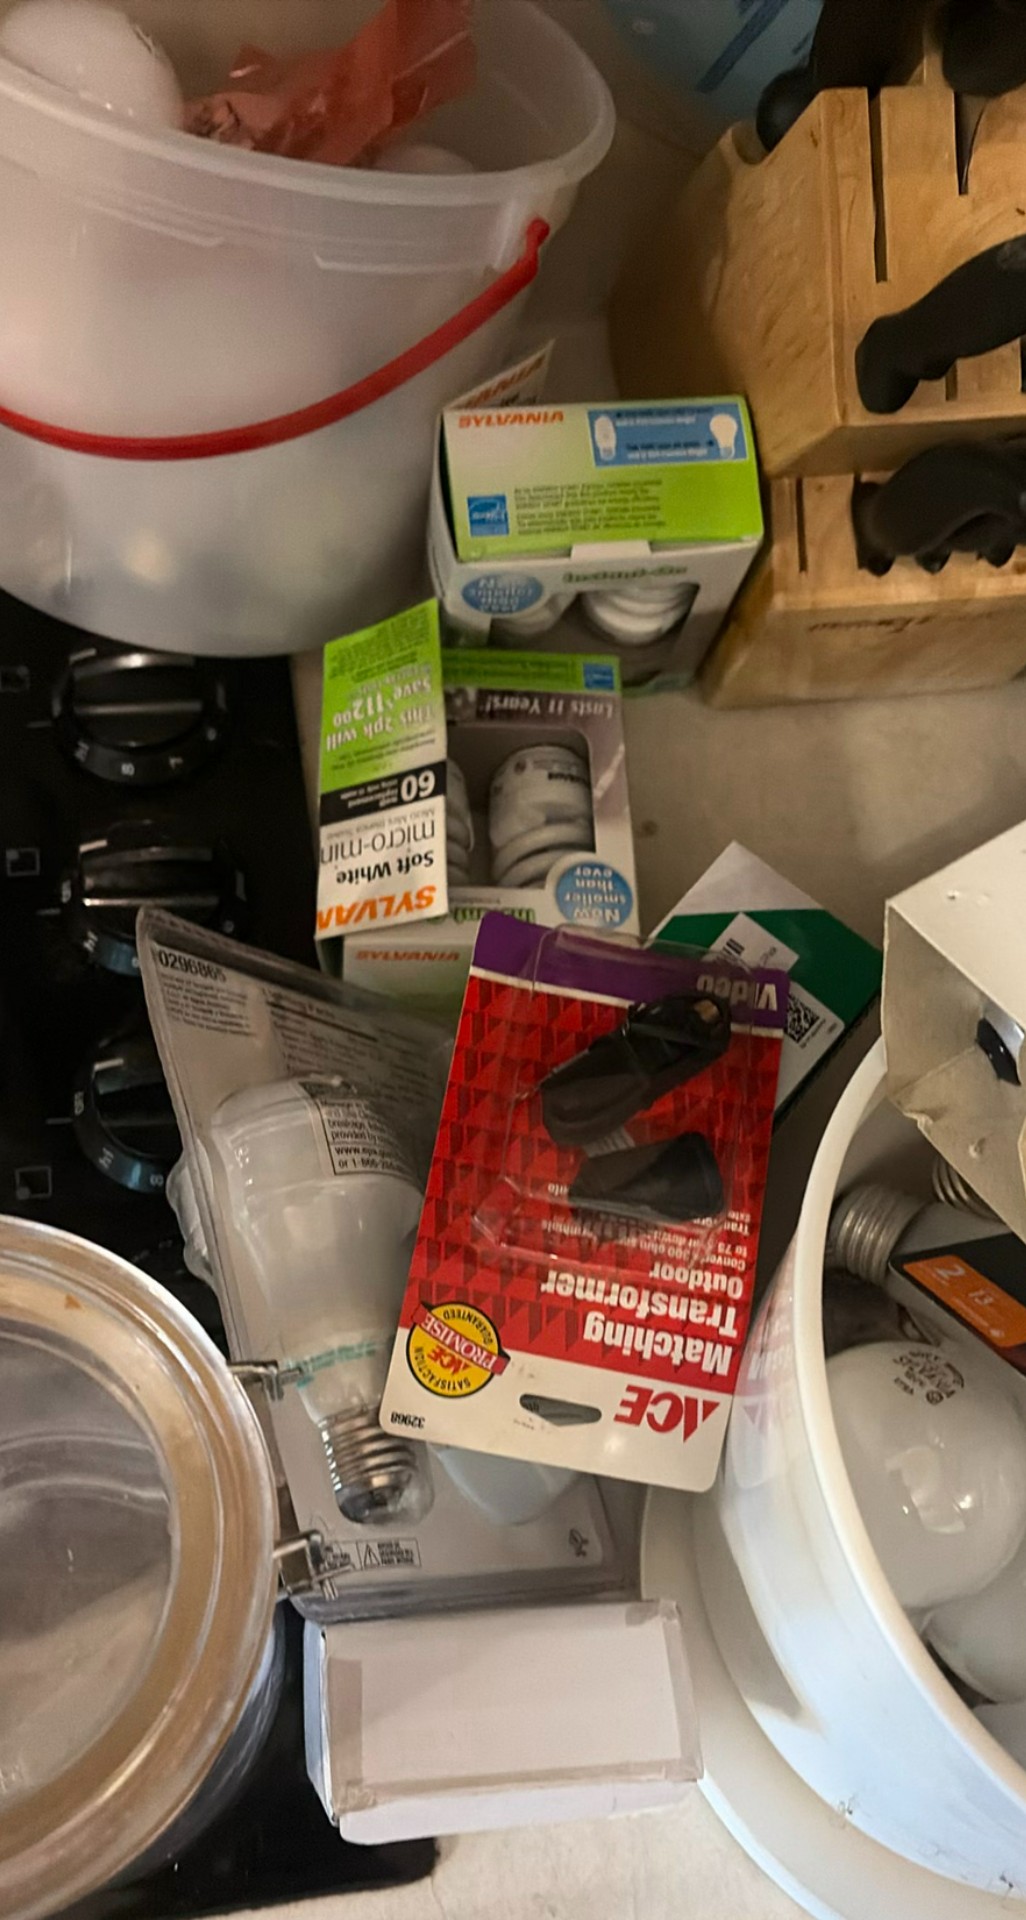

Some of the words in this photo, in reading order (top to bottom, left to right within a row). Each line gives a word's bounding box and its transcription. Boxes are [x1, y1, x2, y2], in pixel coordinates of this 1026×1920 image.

[458, 410, 564, 429] SYLVANIA
[394, 676, 432, 703] Save
[399, 703, 433, 725] This
[570, 699, 614, 719] Lasts
[325, 729, 358, 751] will
[362, 714, 394, 740] 2pk
[400, 770, 436, 803] 60
[336, 860, 392, 885] White
[396, 849, 435, 876] Soft
[573, 865, 613, 879] ever
[574, 877, 614, 892] than
[564, 891, 626, 905] smaller
[717, 1242, 733, 1256] 75
[735, 1243, 748, 1258] to
[648, 1260, 744, 1300] Outdoor
[540, 1269, 738, 1337] Transformer
[442, 1309, 493, 1346] GUARANTEED
[420, 1313, 498, 1370] PROMISE
[583, 1312, 733, 1376] Matching
[414, 1346, 471, 1392] SATISFACTION
[427, 1346, 472, 1377] ACE
[613, 1383, 720, 1444] ACE
